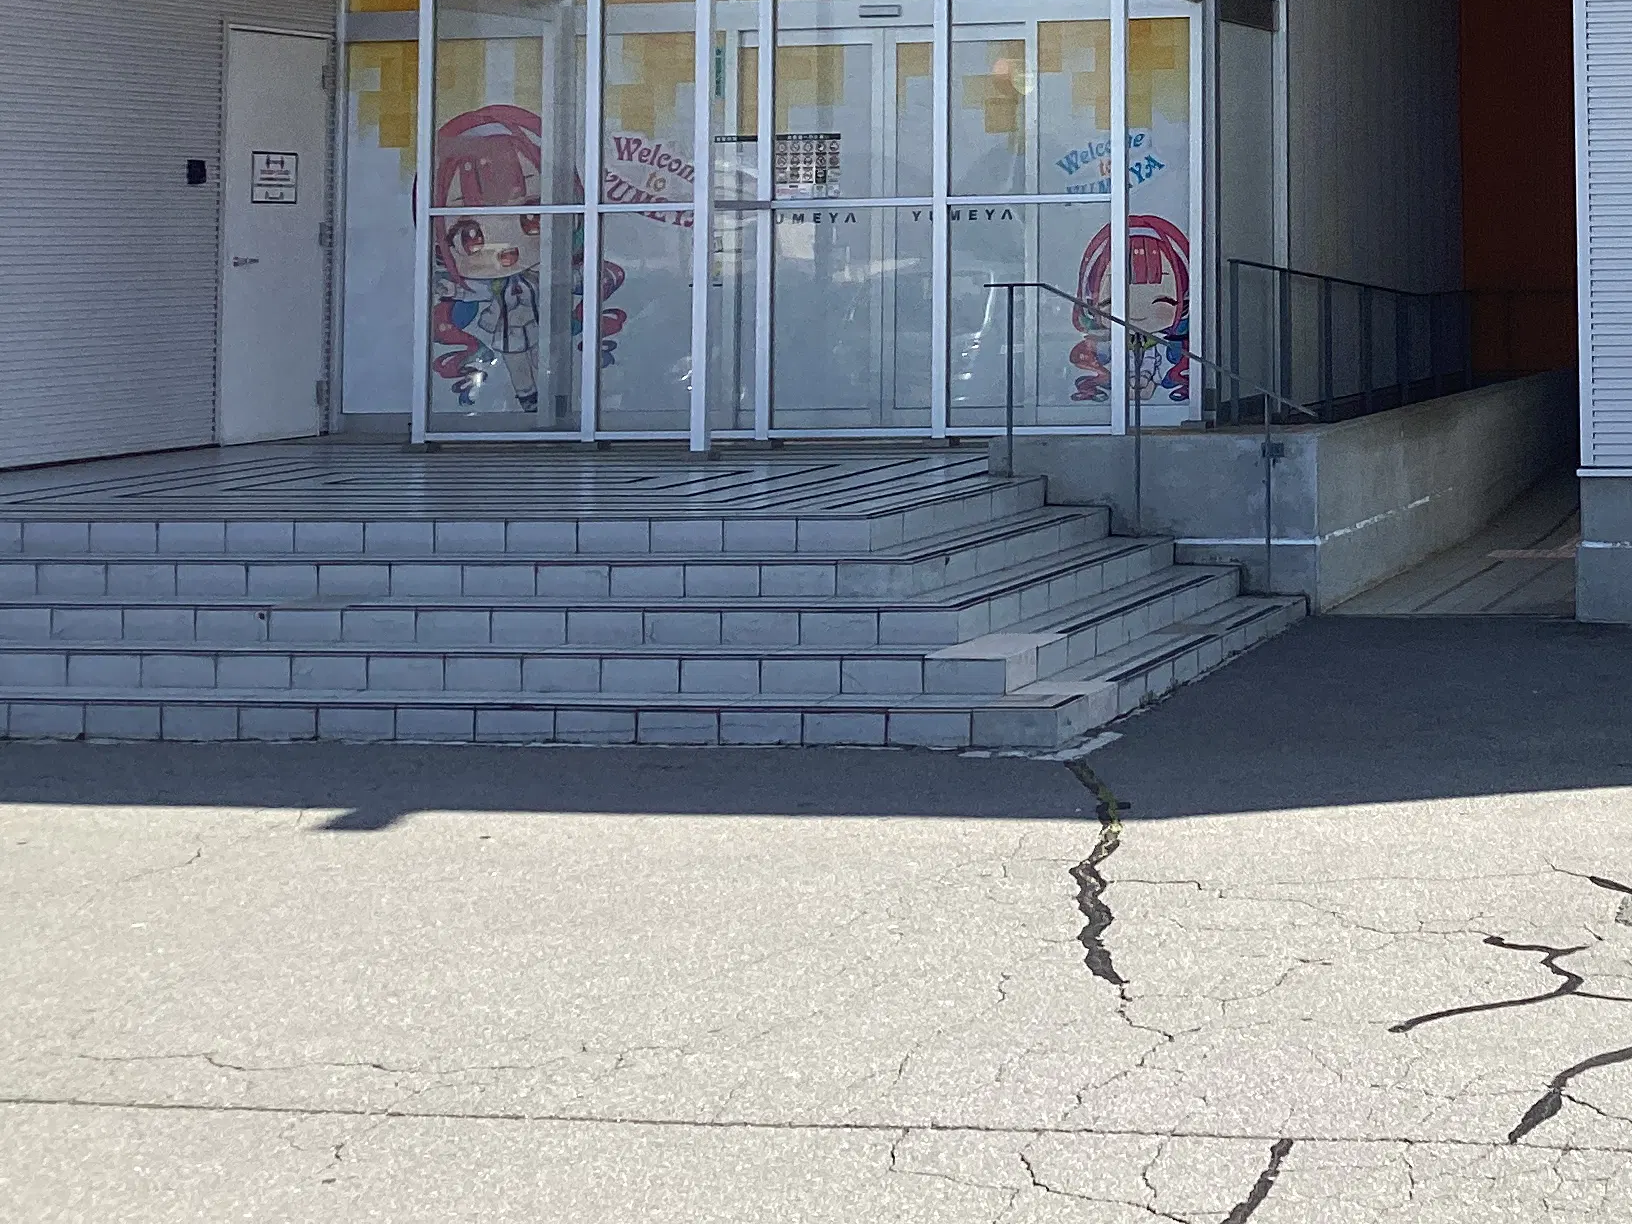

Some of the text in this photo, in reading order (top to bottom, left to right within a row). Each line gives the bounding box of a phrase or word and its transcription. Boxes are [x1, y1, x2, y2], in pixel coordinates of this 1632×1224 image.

[613, 136, 695, 184] Welcom
[1055, 133, 1145, 175] Welcoe
[645, 172, 667, 192] to
[775, 212, 857, 224] UMEYA
[912, 208, 1013, 222] YMEYA
